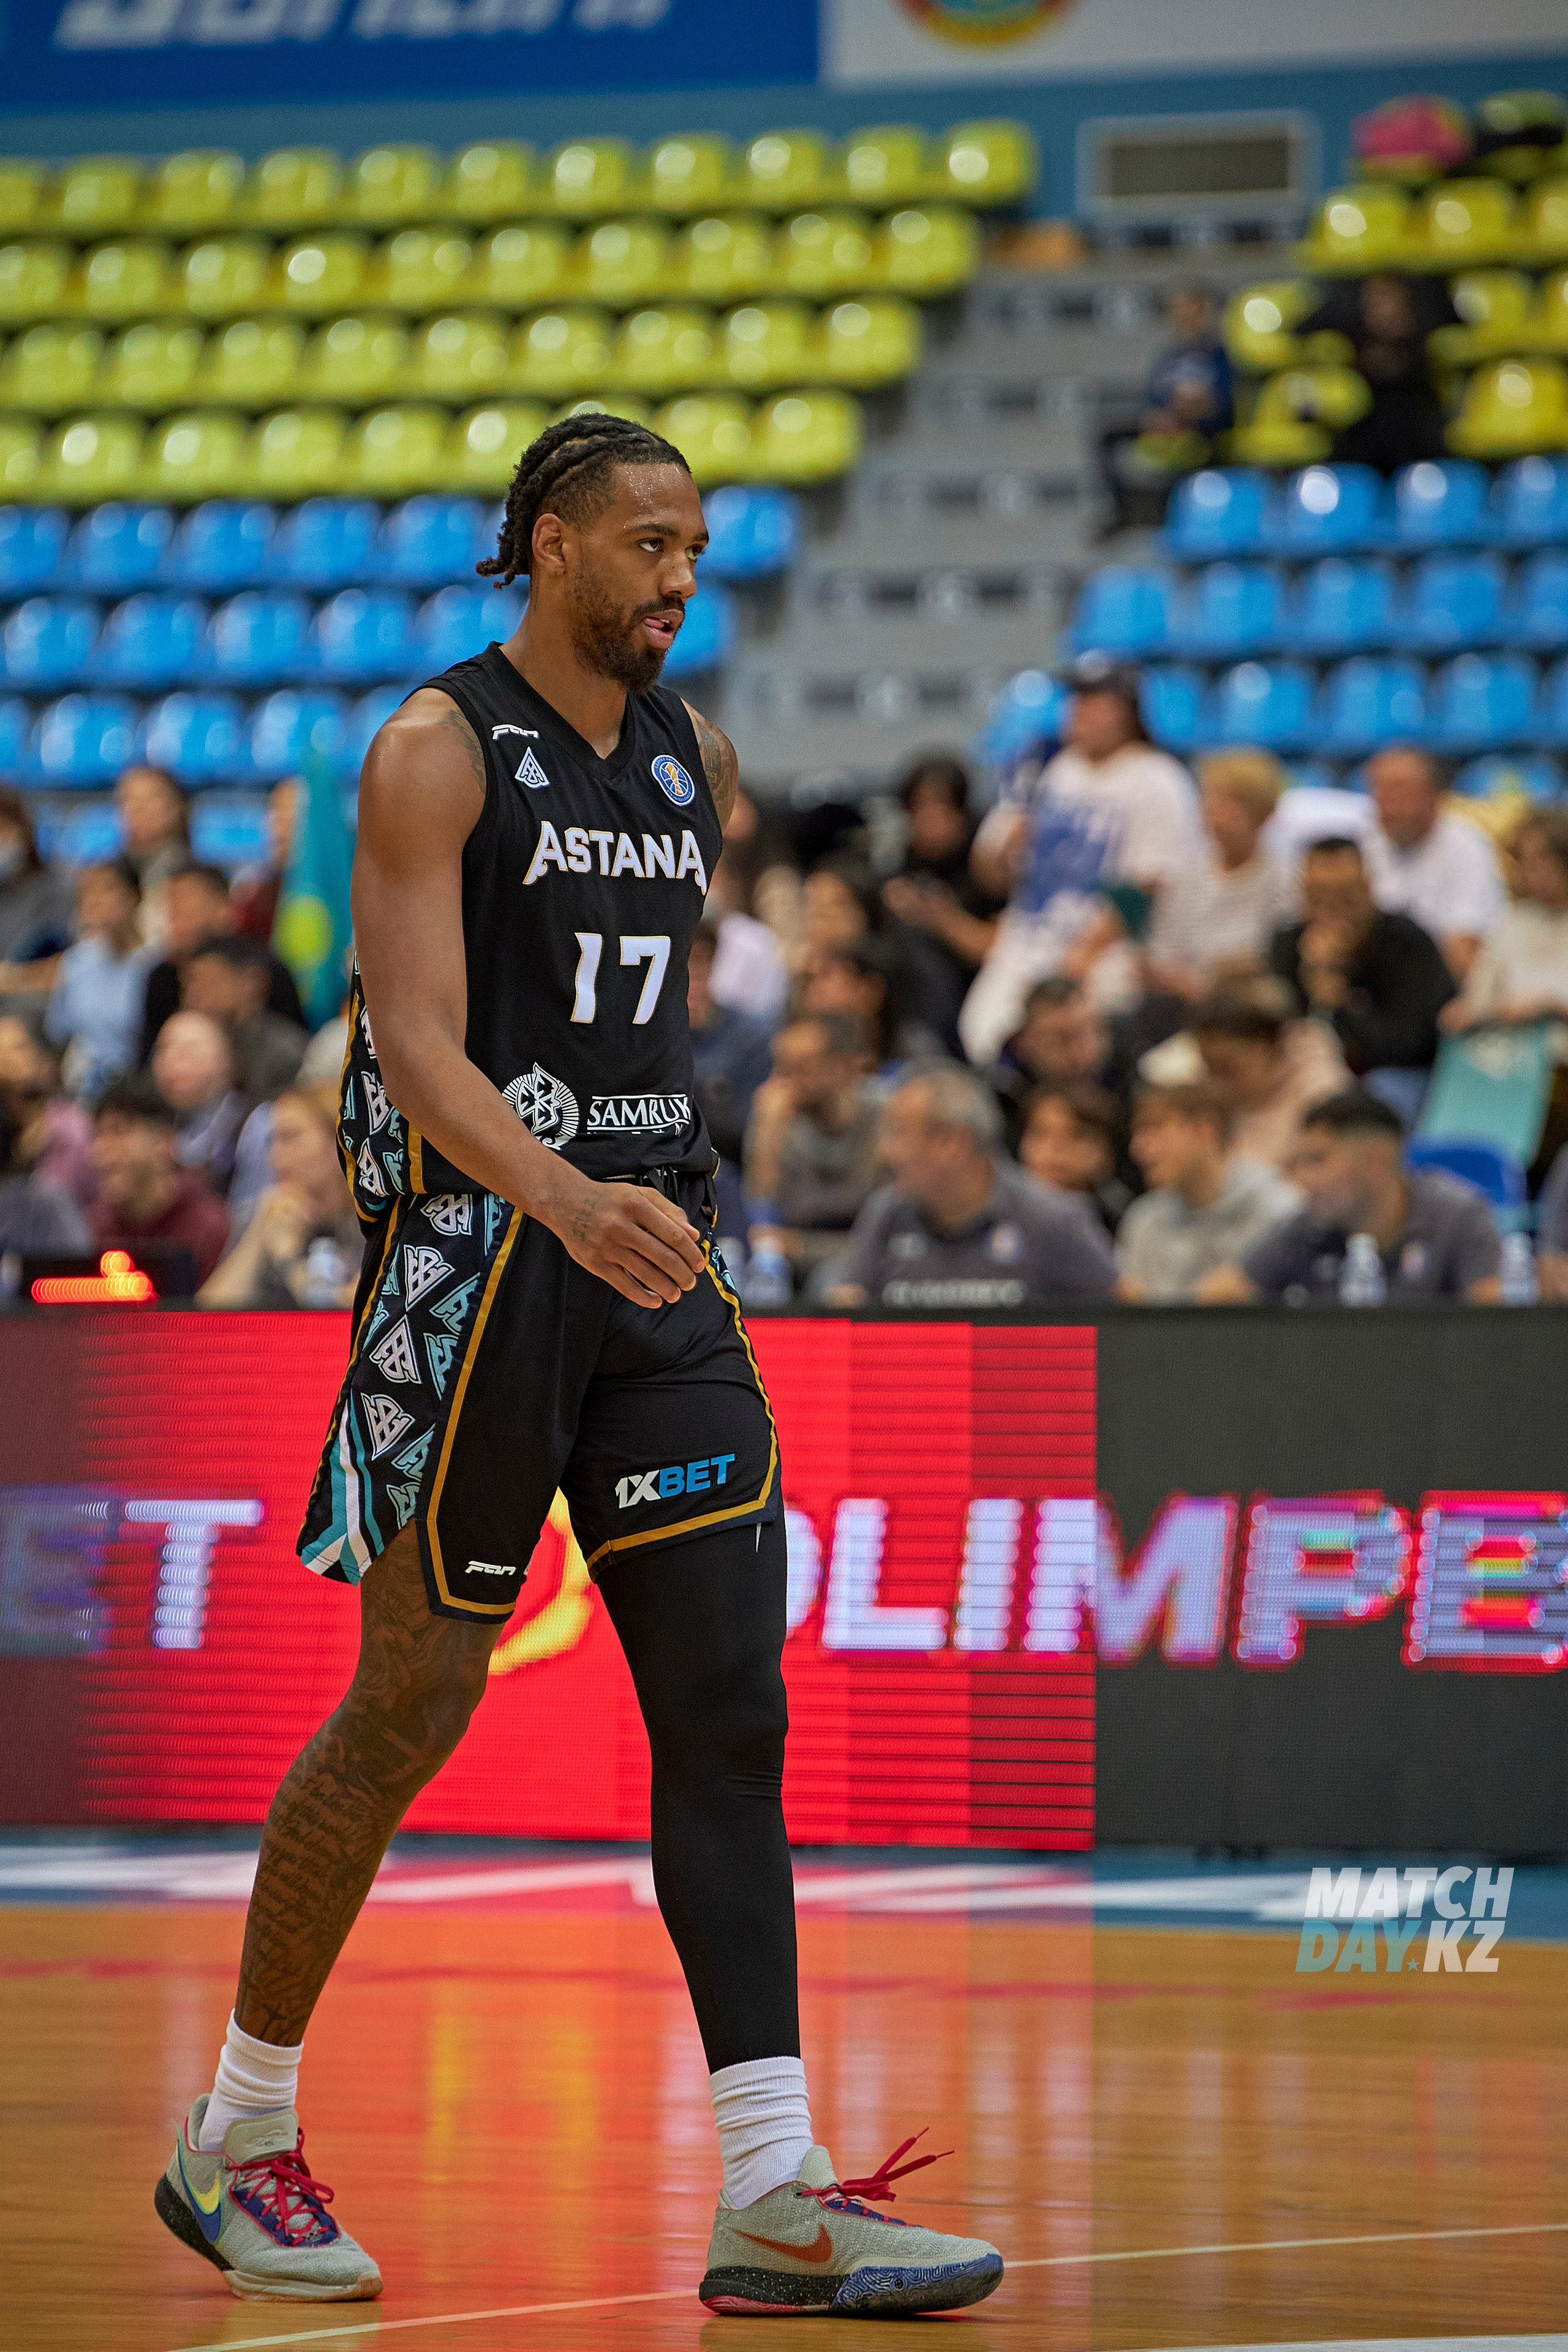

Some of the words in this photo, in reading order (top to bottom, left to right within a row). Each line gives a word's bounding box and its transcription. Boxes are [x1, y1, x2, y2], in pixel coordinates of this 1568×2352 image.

[522, 821, 706, 896] ASTANA
[570, 932, 671, 1024] 17
[587, 1099, 691, 1126] SAMRUK
[615, 1453, 735, 1509] 1XBET
[786, 1491, 1568, 1675] LIMPB
